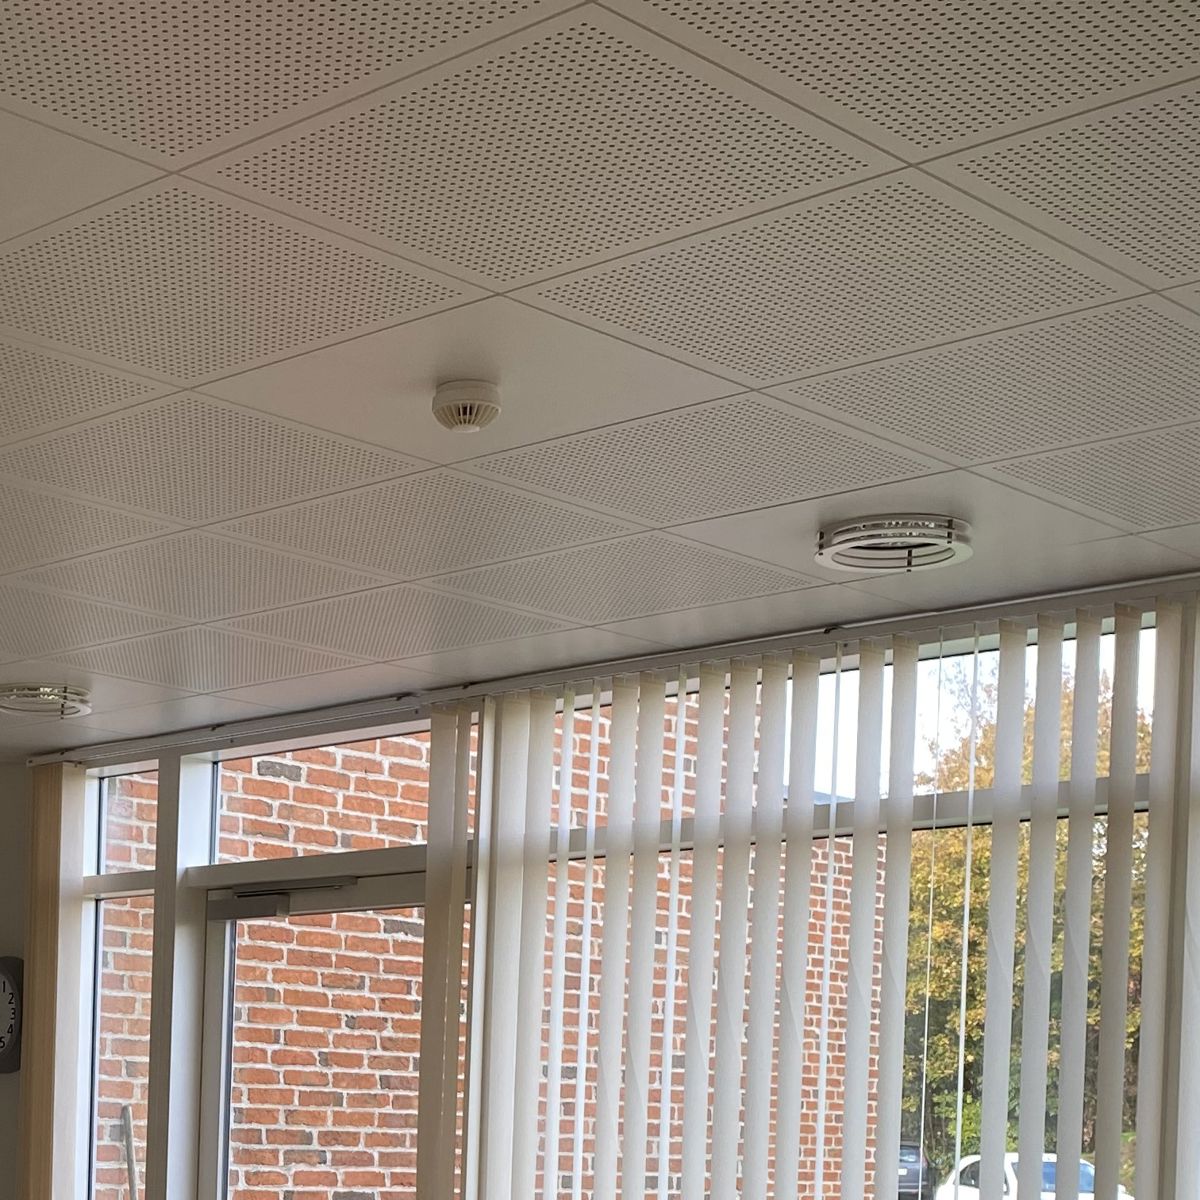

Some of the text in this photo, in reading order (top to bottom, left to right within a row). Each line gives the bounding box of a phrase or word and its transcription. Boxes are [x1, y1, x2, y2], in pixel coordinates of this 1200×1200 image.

[8, 993, 14, 1004] 2
[10, 1008, 16, 1020] 3
[7, 1024, 13, 1034] 4
[0, 1036, 5, 1048] 5
